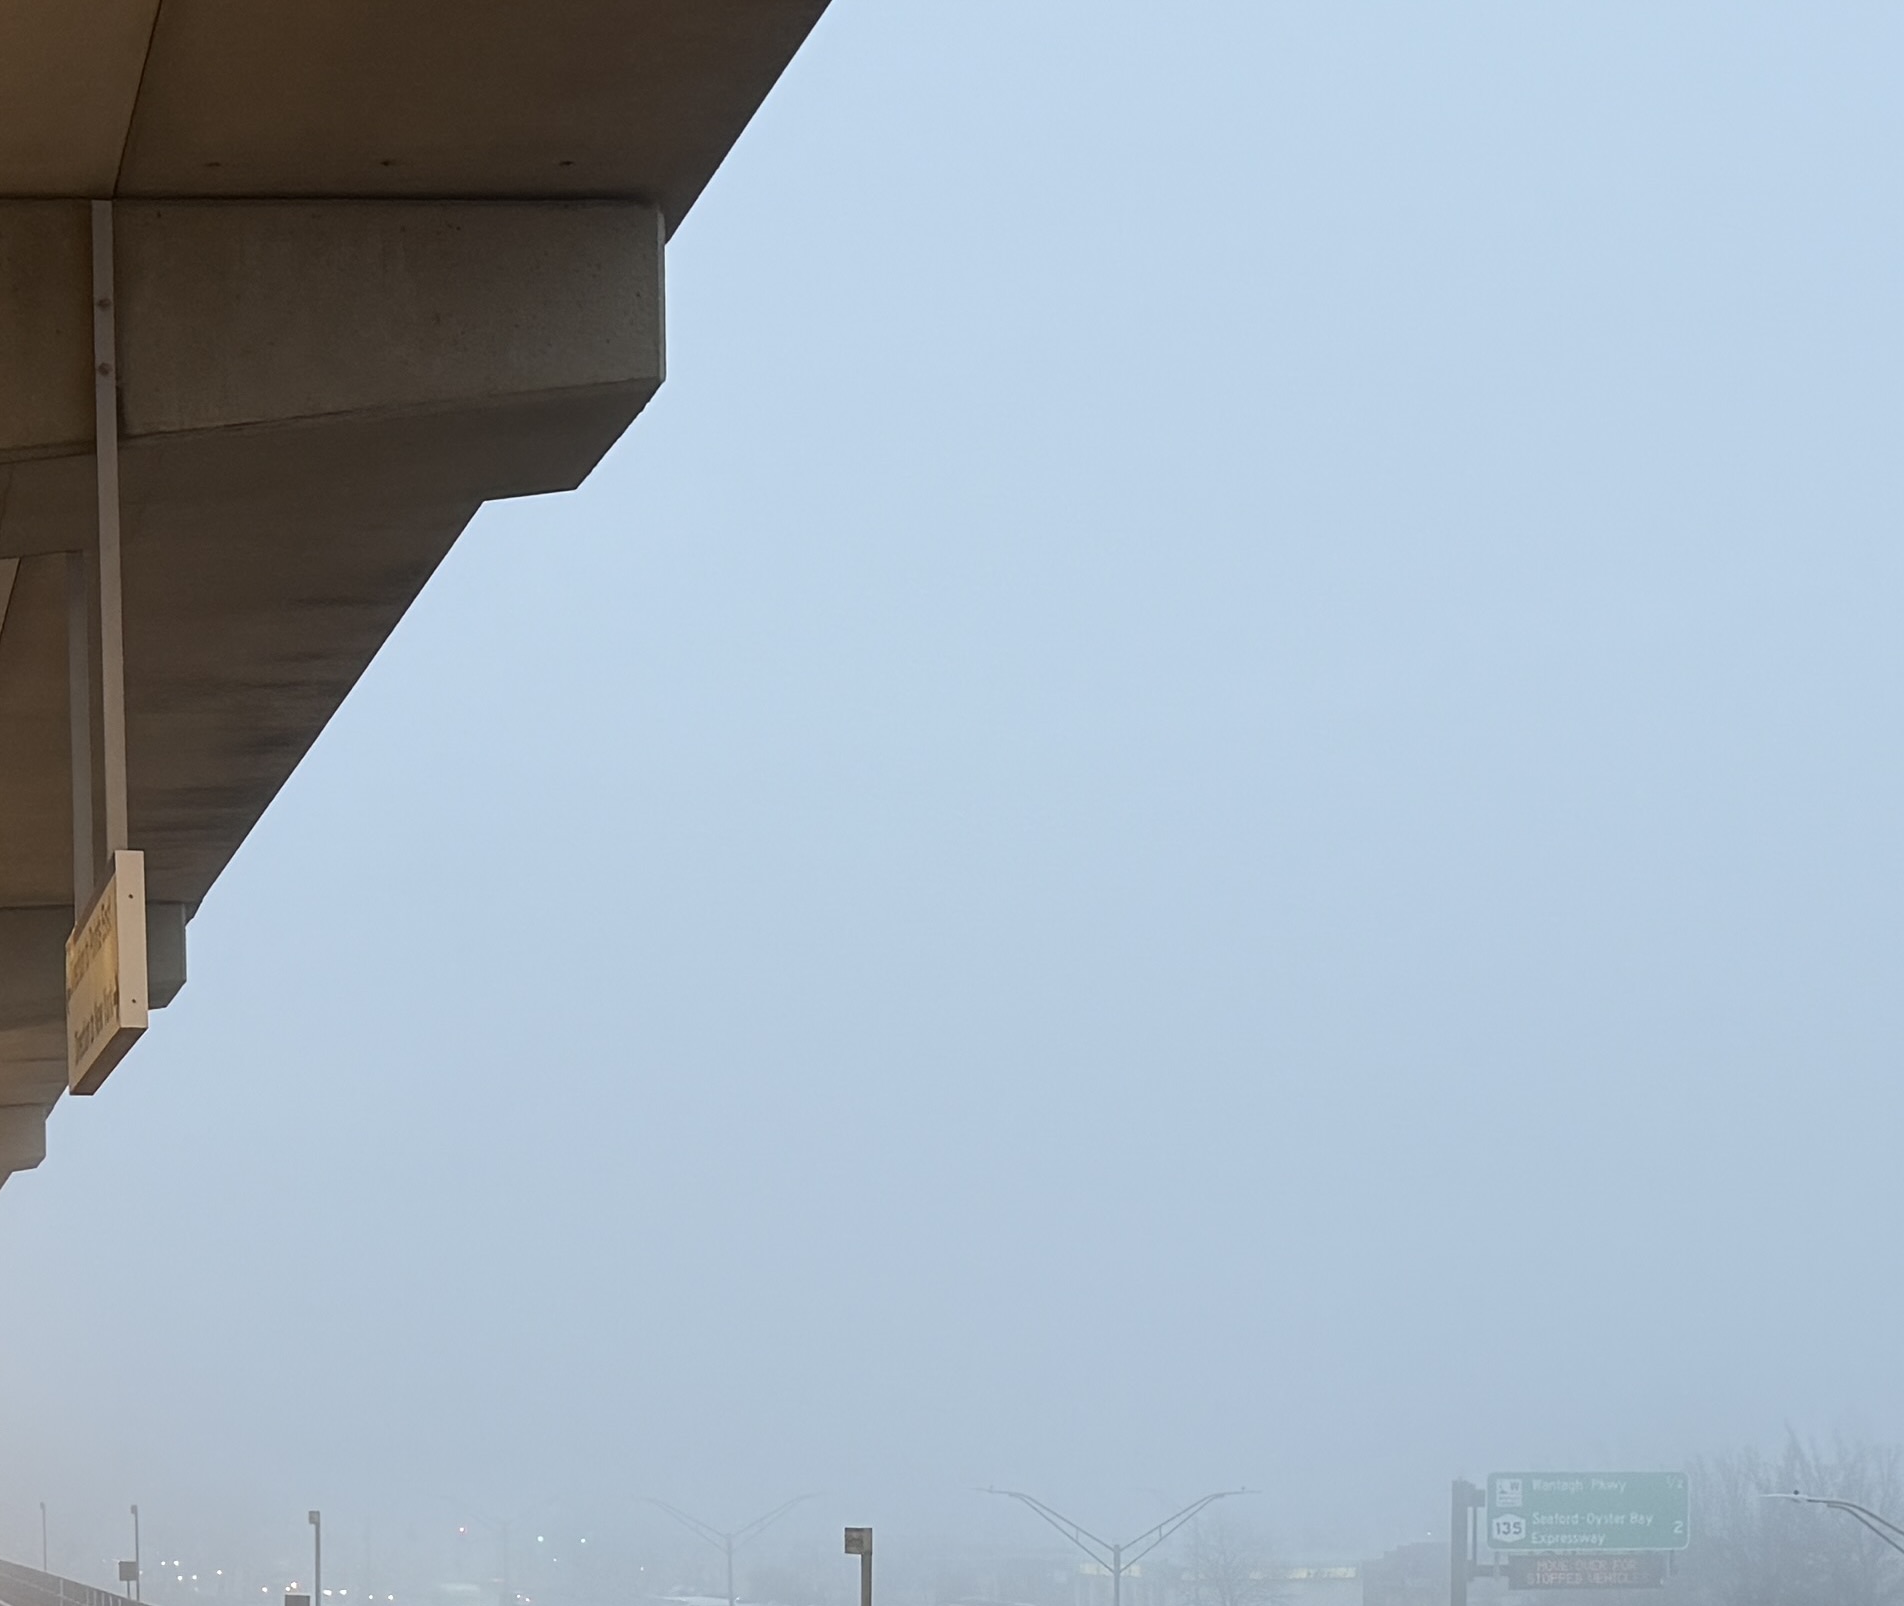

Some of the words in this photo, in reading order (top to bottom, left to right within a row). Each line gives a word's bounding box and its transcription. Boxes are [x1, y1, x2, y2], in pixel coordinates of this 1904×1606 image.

[1591, 1478, 1627, 1494] Pkwy
[1630, 1512, 1655, 1526] Bay
[1496, 1521, 1522, 1535] 135
[1673, 1520, 1684, 1534] 2
[1531, 1532, 1607, 1546] Expressway
